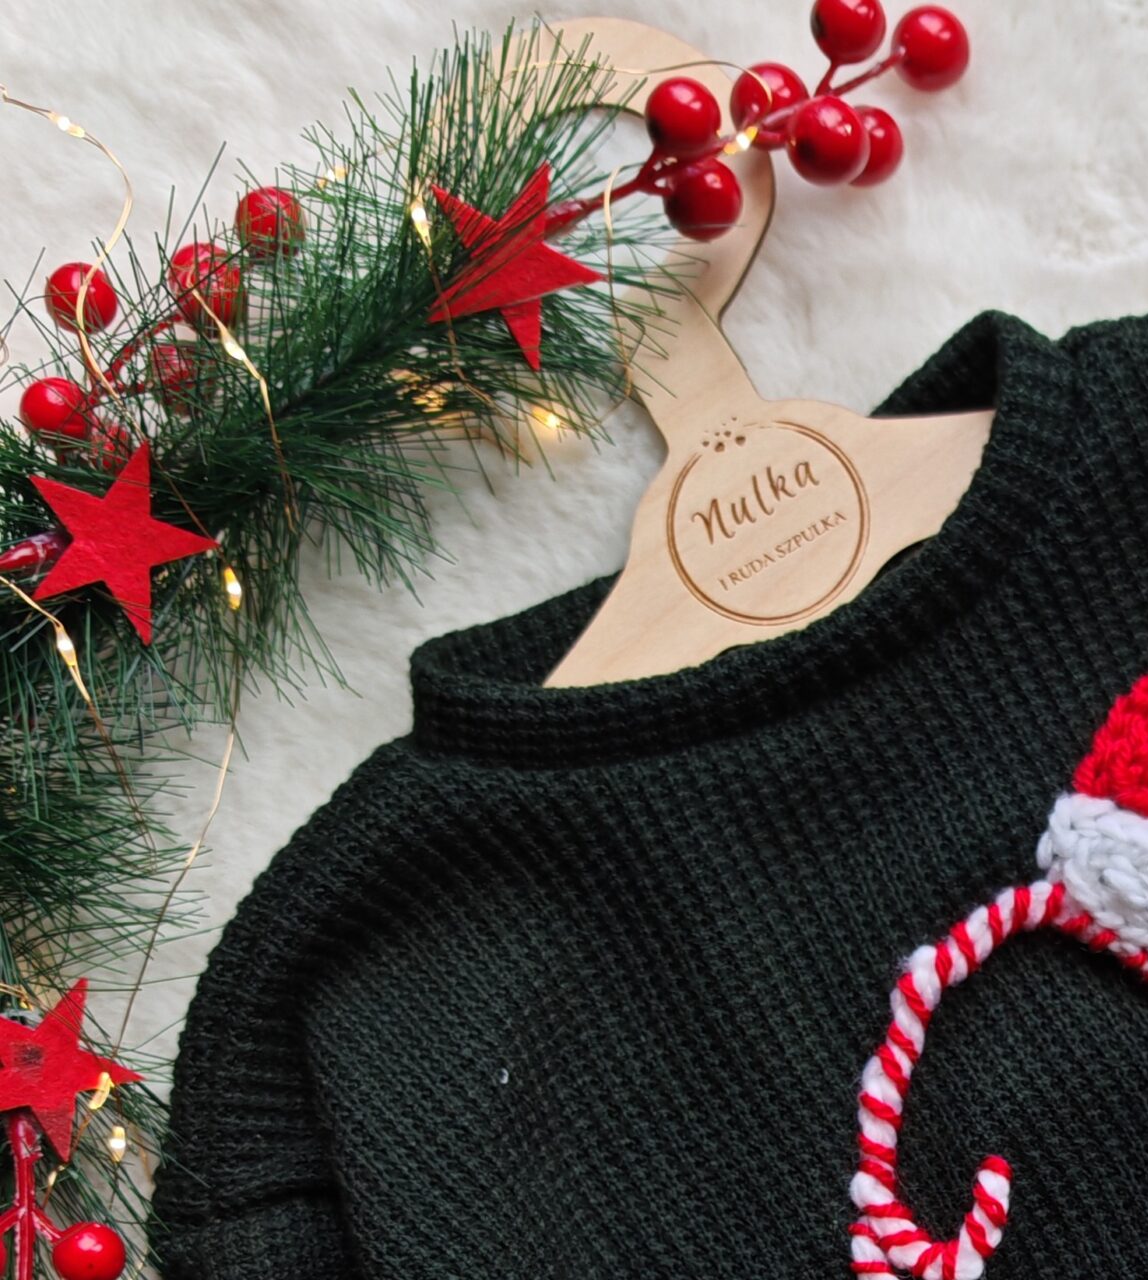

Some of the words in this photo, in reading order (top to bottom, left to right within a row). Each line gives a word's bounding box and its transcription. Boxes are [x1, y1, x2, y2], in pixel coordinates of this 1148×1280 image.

[691, 461, 820, 545] Nulka
[728, 553, 776, 586] RUDA
[774, 511, 848, 559] SZPULKA
